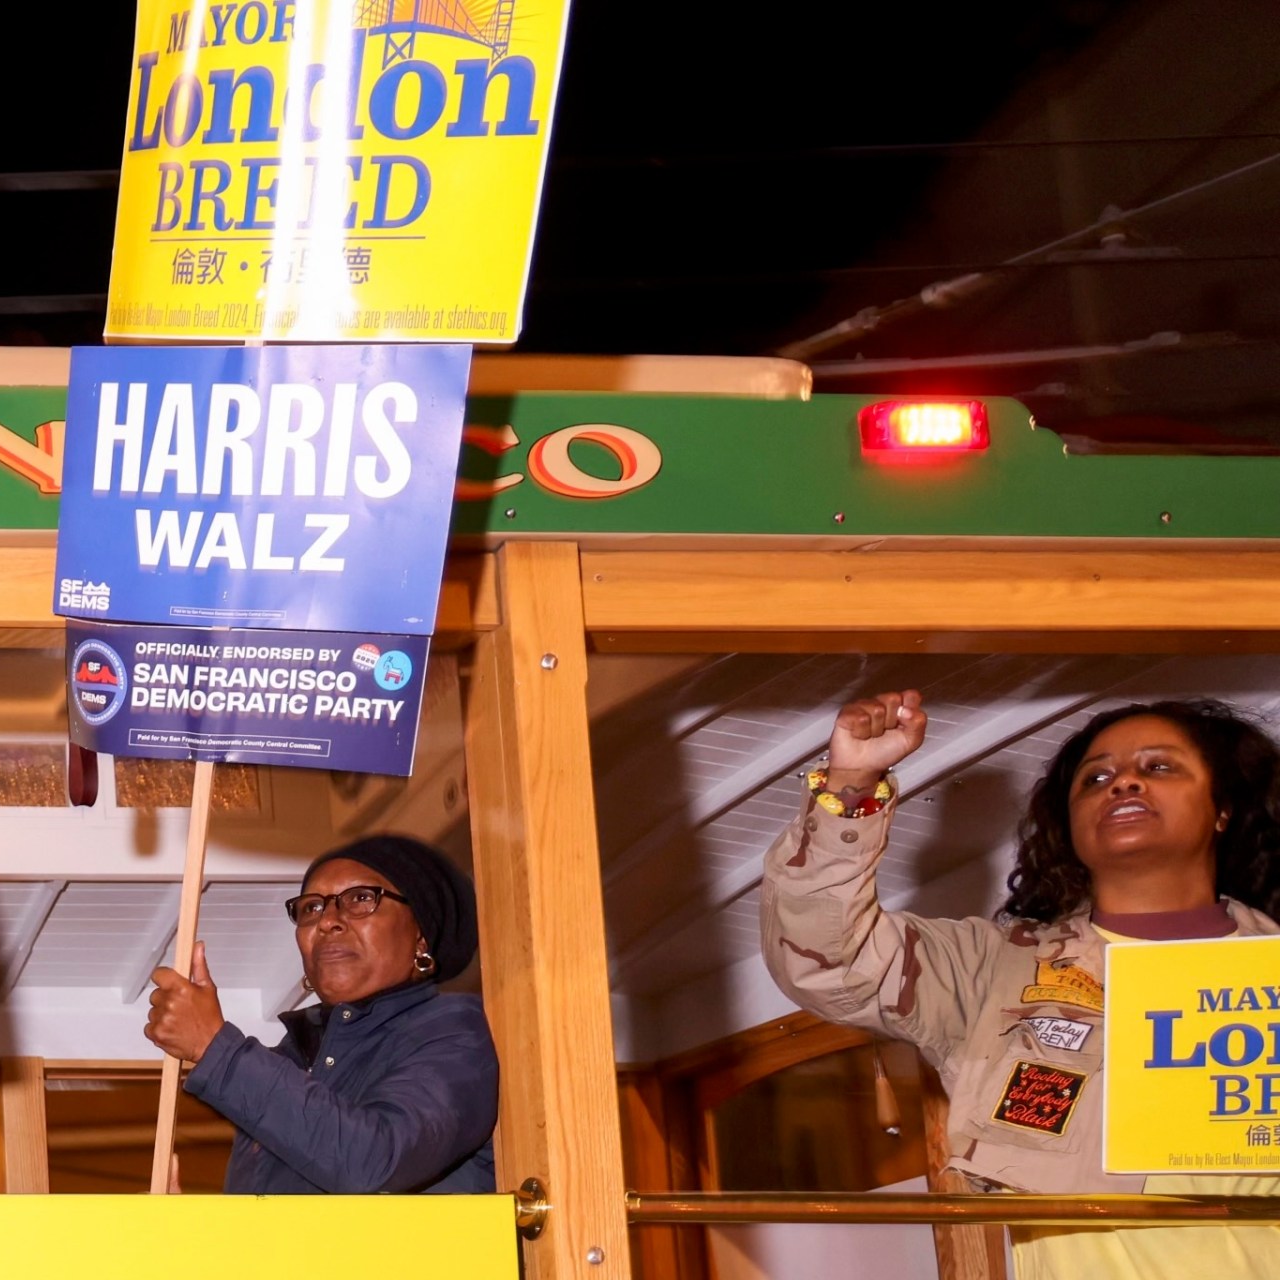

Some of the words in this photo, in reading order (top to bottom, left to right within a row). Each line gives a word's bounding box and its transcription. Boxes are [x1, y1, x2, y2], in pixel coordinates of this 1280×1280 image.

[168, 0, 300, 54] MAYOR
[128, 27, 539, 154] London
[193, 303, 219, 328] Breed
[363, 310, 380, 329] are
[383, 304, 429, 330] available
[433, 307, 445, 329] at
[92, 381, 418, 499] HARRIS
[135, 508, 351, 573] WALZ
[61, 578, 83, 594] SF
[59, 594, 110, 611] DEMS
[135, 641, 219, 660] OFFICIALLY
[223, 646, 314, 661] ENDORSED
[318, 649, 341, 662] BY
[88, 662, 100, 671] SF
[133, 662, 188, 685] SAN
[193, 666, 357, 692] FRANCISCO
[81, 691, 107, 705] DEMS
[131, 686, 308, 715] DEMOCRATIC
[314, 696, 404, 721] PARTY
[160, 735, 168, 743] by
[208, 738, 242, 746] Democratic
[243, 739, 265, 748] County
[266, 740, 288, 748] Central
[1036, 1033, 1076, 1049] REN!
[1043, 1019, 1085, 1042] Today
[1144, 1010, 1280, 1069] Lo
[1020, 1066, 1074, 1090] Rooting
[1026, 1080, 1051, 1096] for
[1009, 1085, 1073, 1110] Everybody
[1004, 1104, 1062, 1128] Black
[1245, 1124, 1280, 1147] 倫
[1168, 1153, 1183, 1166] Paid
[1184, 1153, 1193, 1165] for
[1195, 1153, 1203, 1168] by
[1233, 1152, 1253, 1168] Mayor
